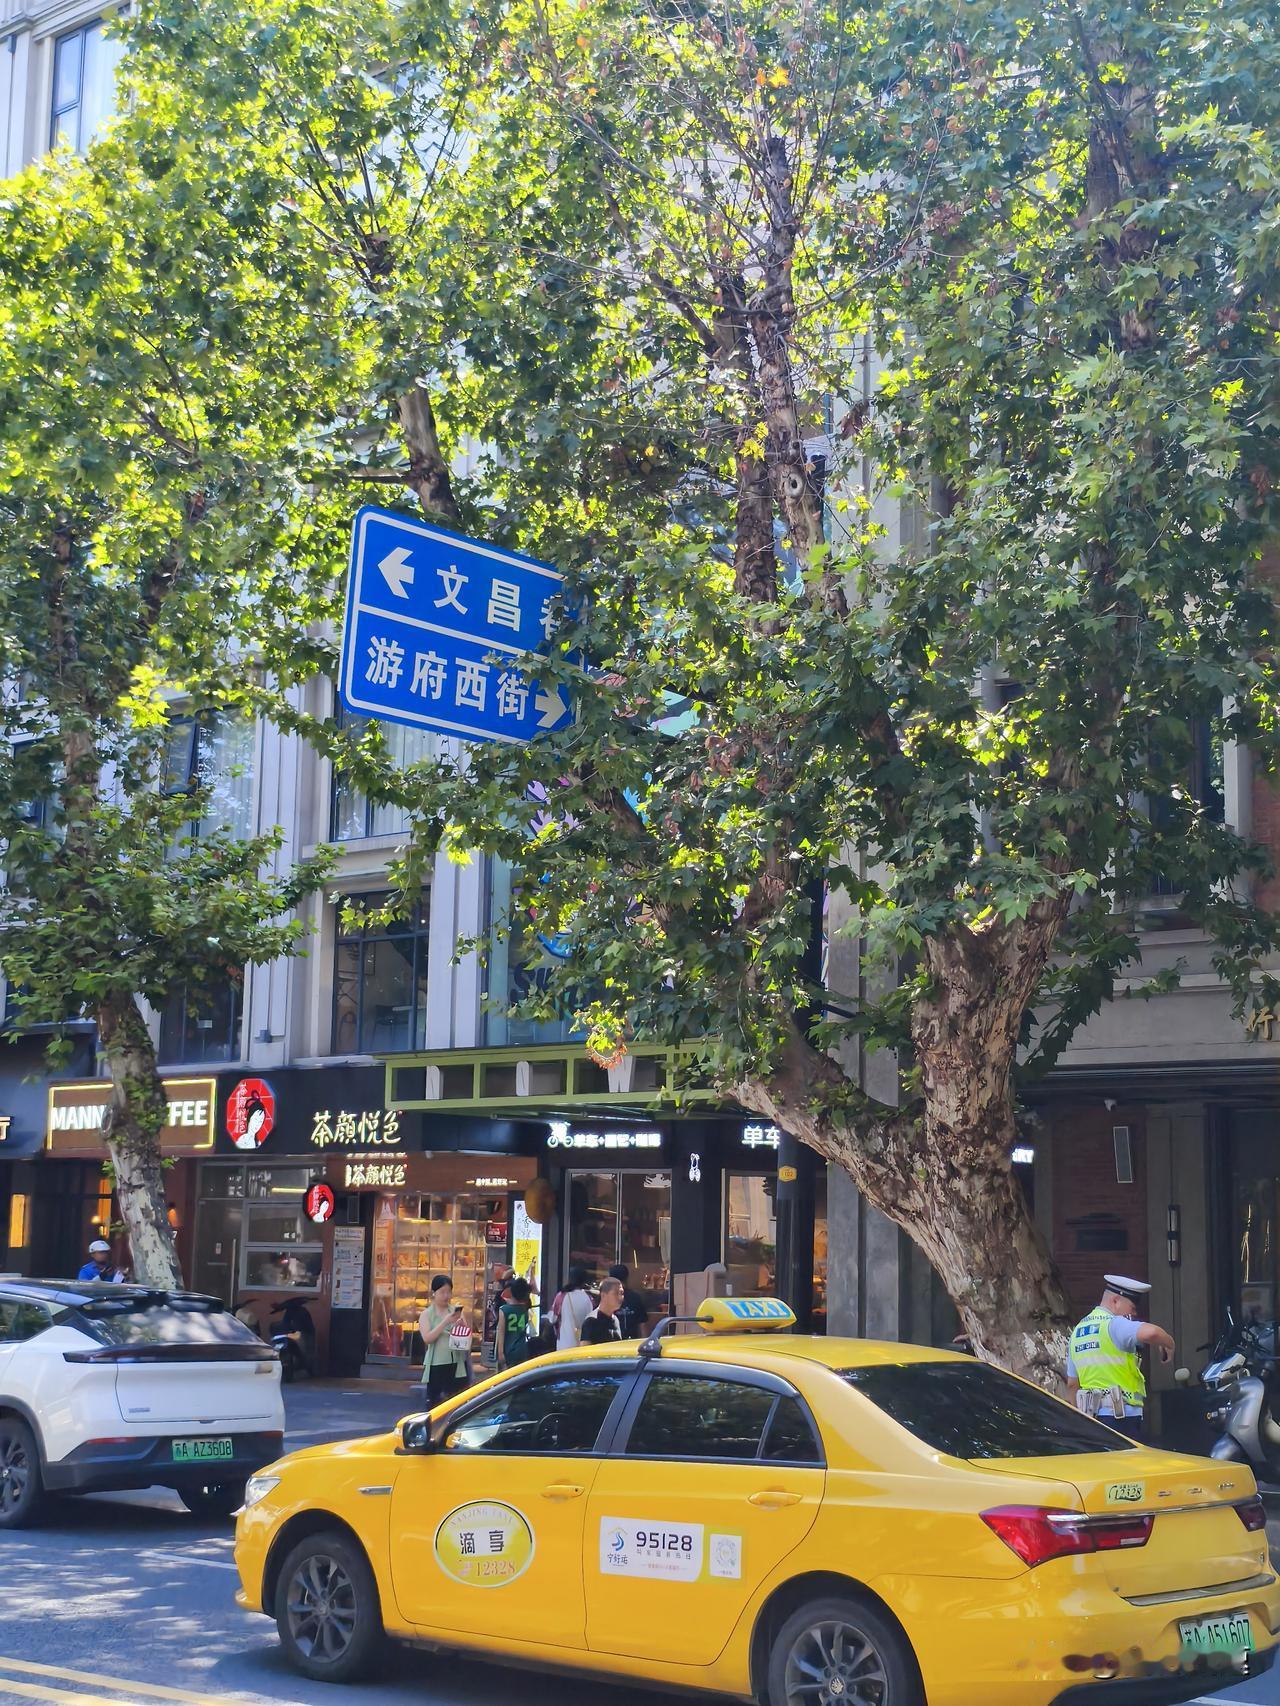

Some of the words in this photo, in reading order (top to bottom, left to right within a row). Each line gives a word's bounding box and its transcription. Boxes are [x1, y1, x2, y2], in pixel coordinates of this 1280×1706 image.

[365, 635, 529, 721] 游府西街
[51, 1104, 106, 1131] MANN
[168, 1100, 209, 1127] FEE
[742, 1125, 780, 1149] 单车
[727, 1301, 787, 1317] TAXI
[508, 1313, 526, 1331] 24
[459, 1530, 505, 1555] 滴享
[636, 1531, 693, 1552] 95128
[476, 1560, 516, 1577] 12328
